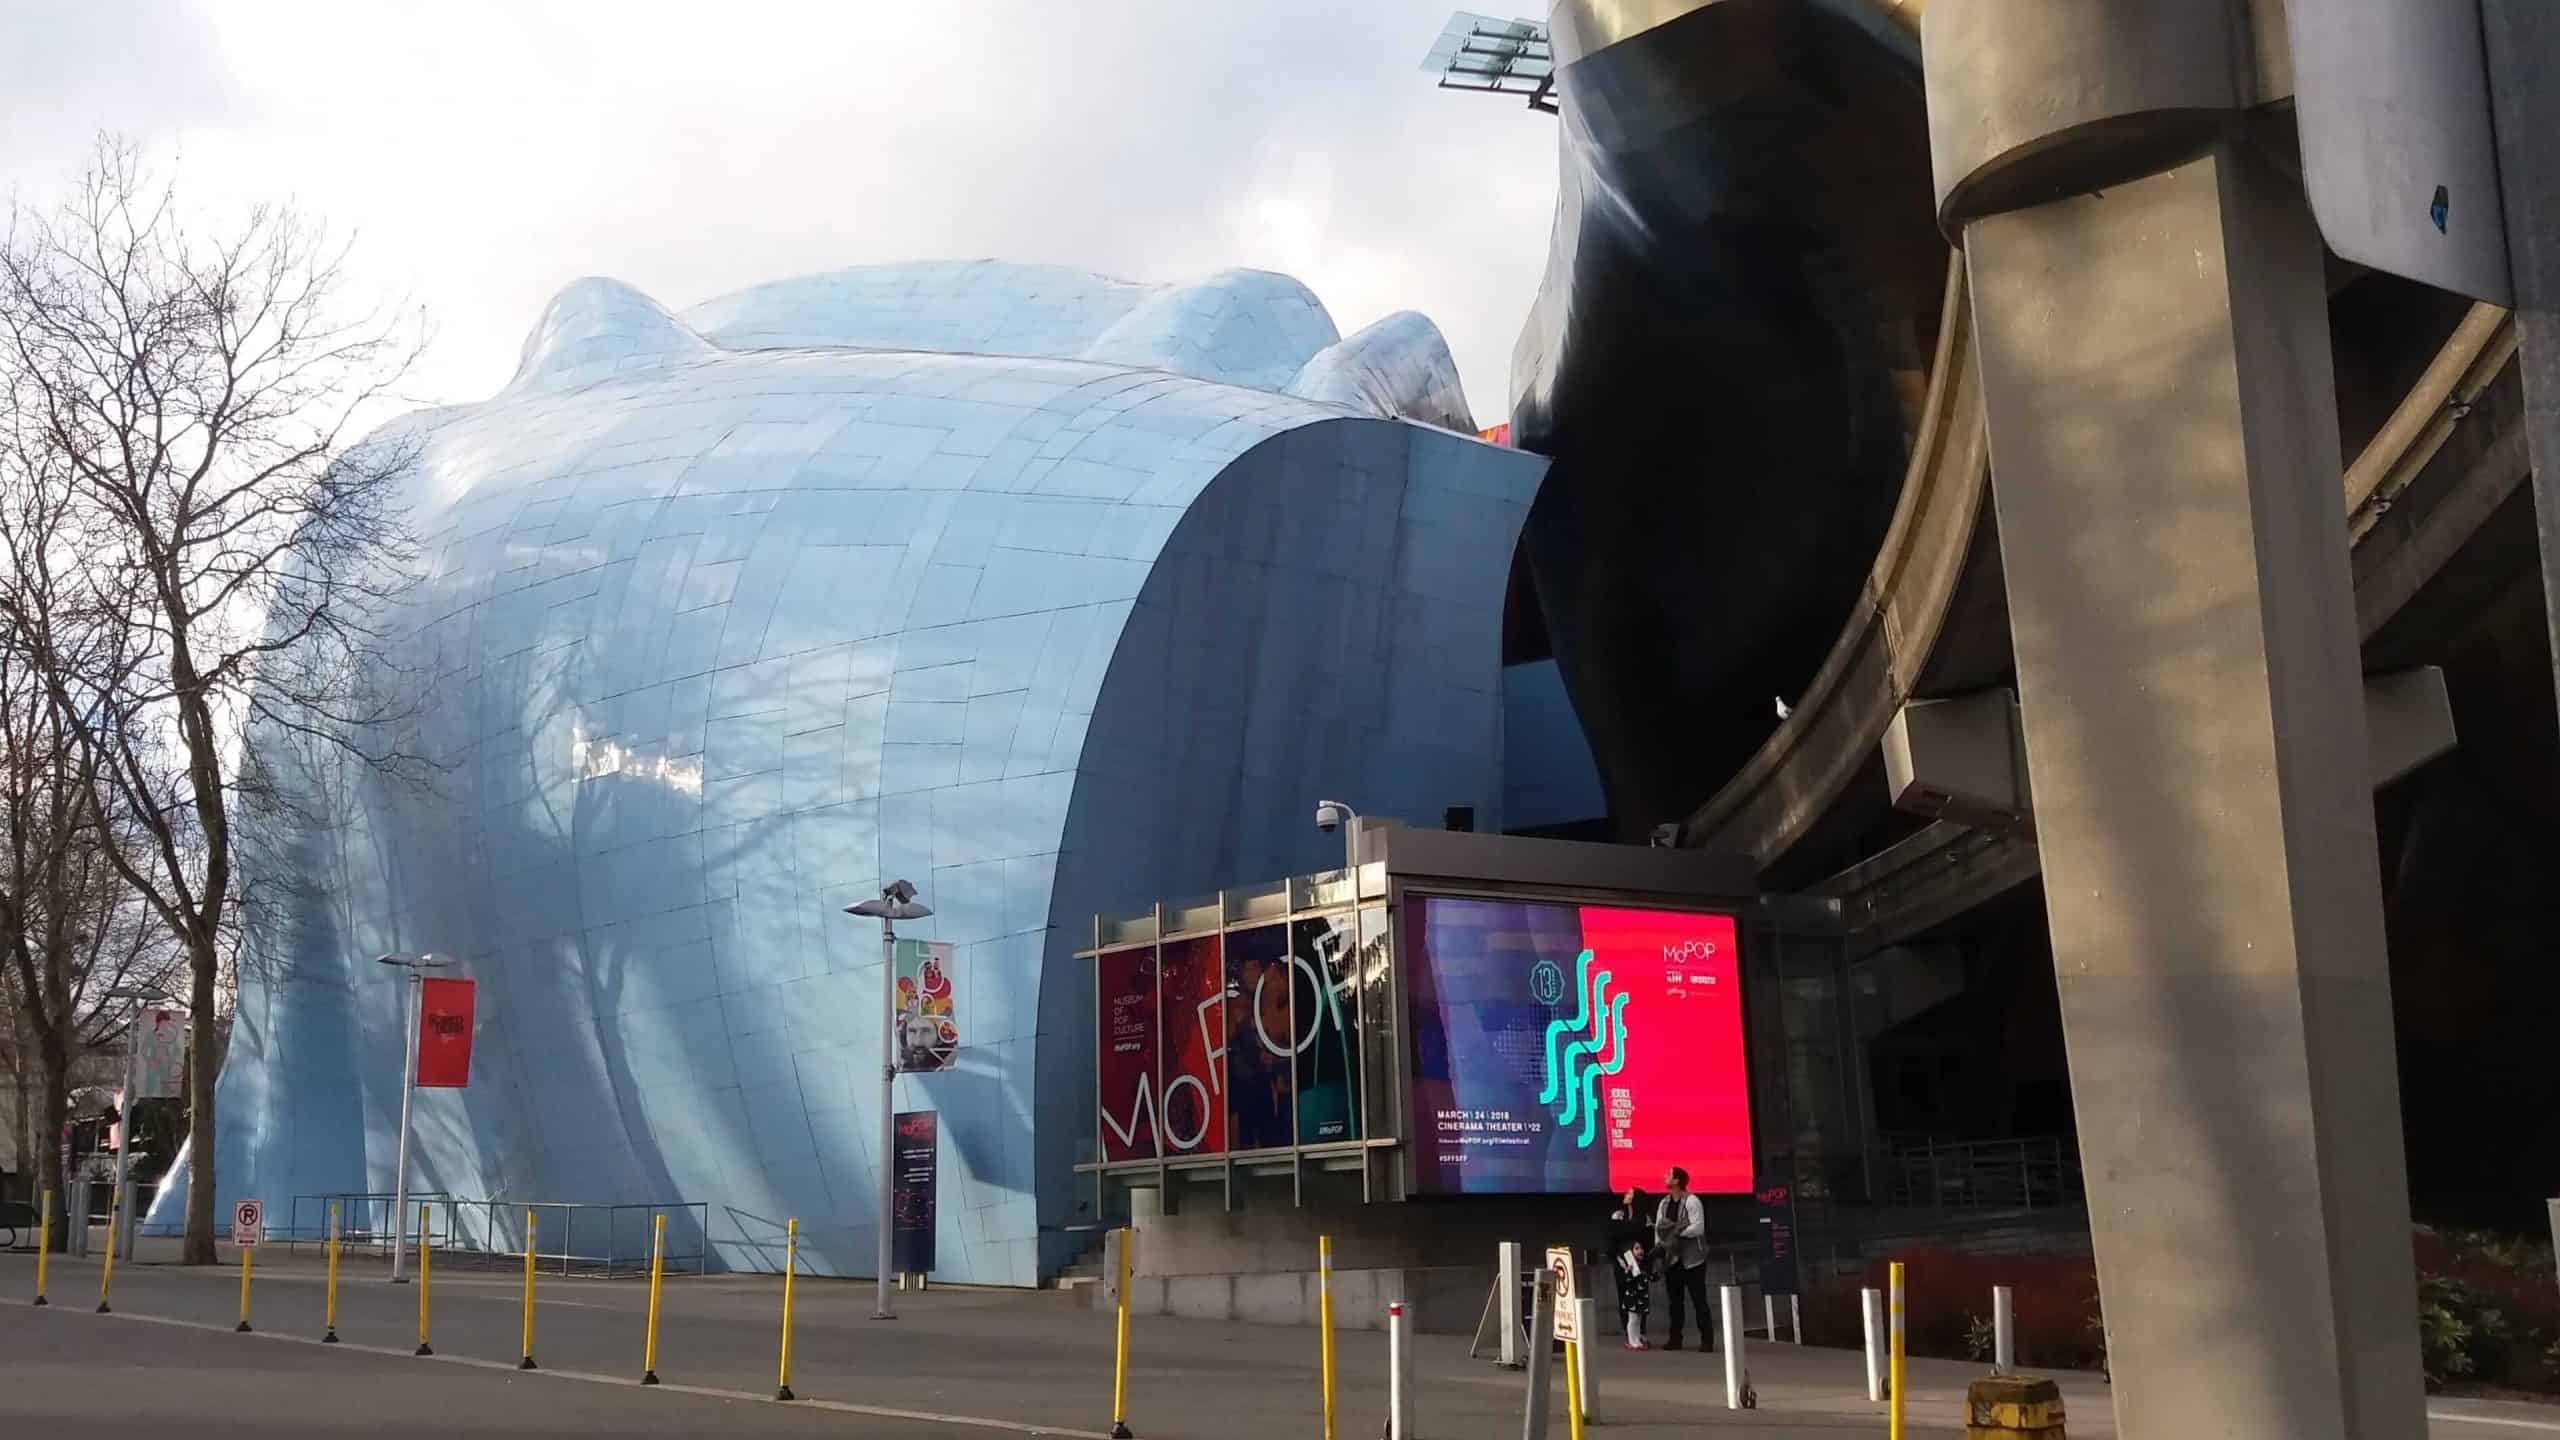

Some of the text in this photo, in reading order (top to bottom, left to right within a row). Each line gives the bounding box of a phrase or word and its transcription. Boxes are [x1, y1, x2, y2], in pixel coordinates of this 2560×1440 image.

[1113, 1023, 1145, 1034] CULTURE
[1438, 1111, 1469, 1120] MARCH
[1475, 1111, 1485, 1120] 24
[1491, 1112, 1510, 1120] 2018
[1438, 1122, 1483, 1131] CINERAMA
[1486, 1122, 1522, 1132] THEATER
